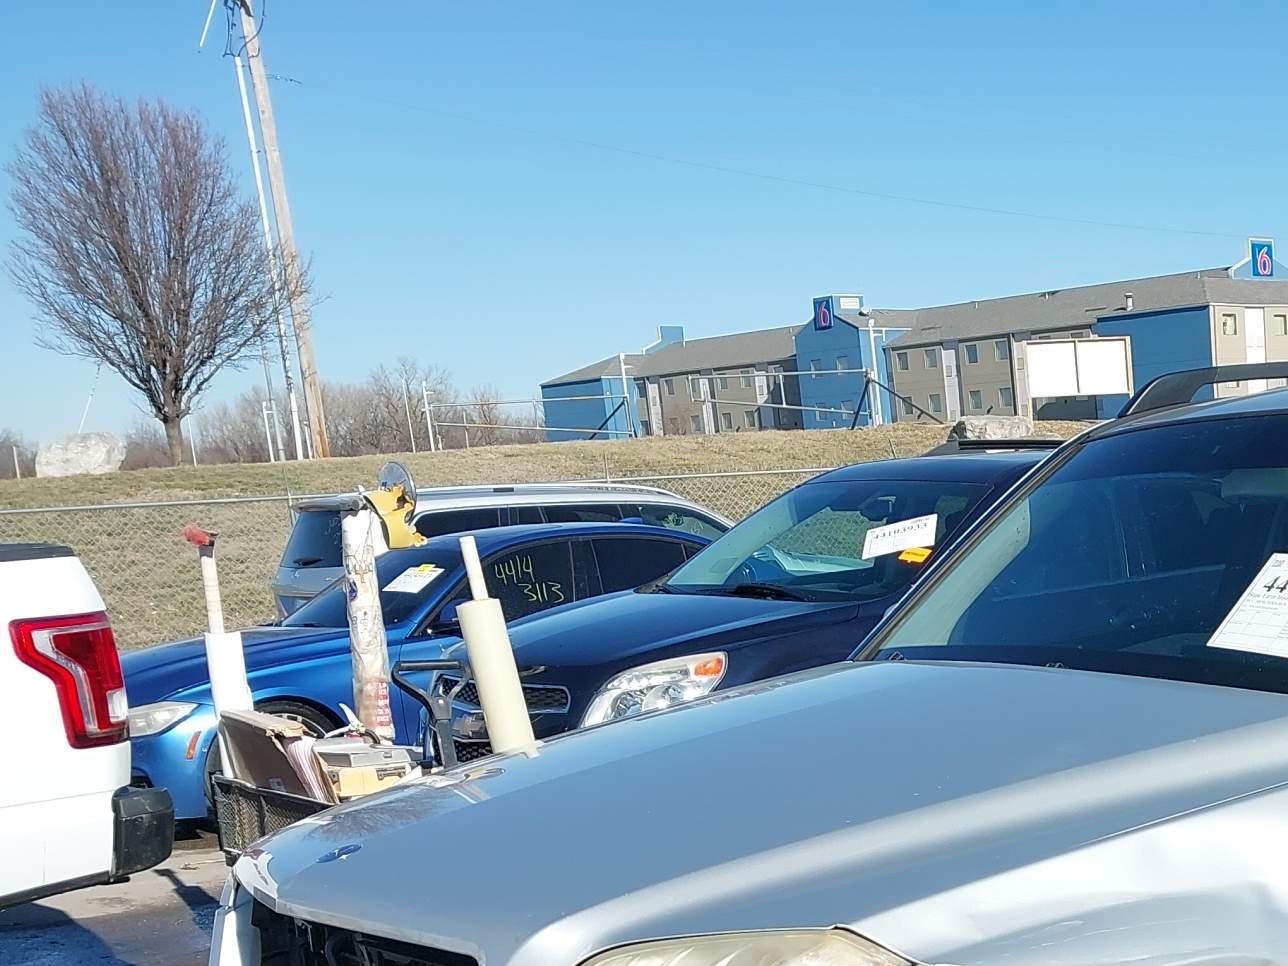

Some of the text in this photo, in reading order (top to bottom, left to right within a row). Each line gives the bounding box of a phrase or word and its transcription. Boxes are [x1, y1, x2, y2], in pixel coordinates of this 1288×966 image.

[1258, 246, 1272, 276] 6
[819, 301, 830, 328] 6
[517, 581, 565, 604] 3113
